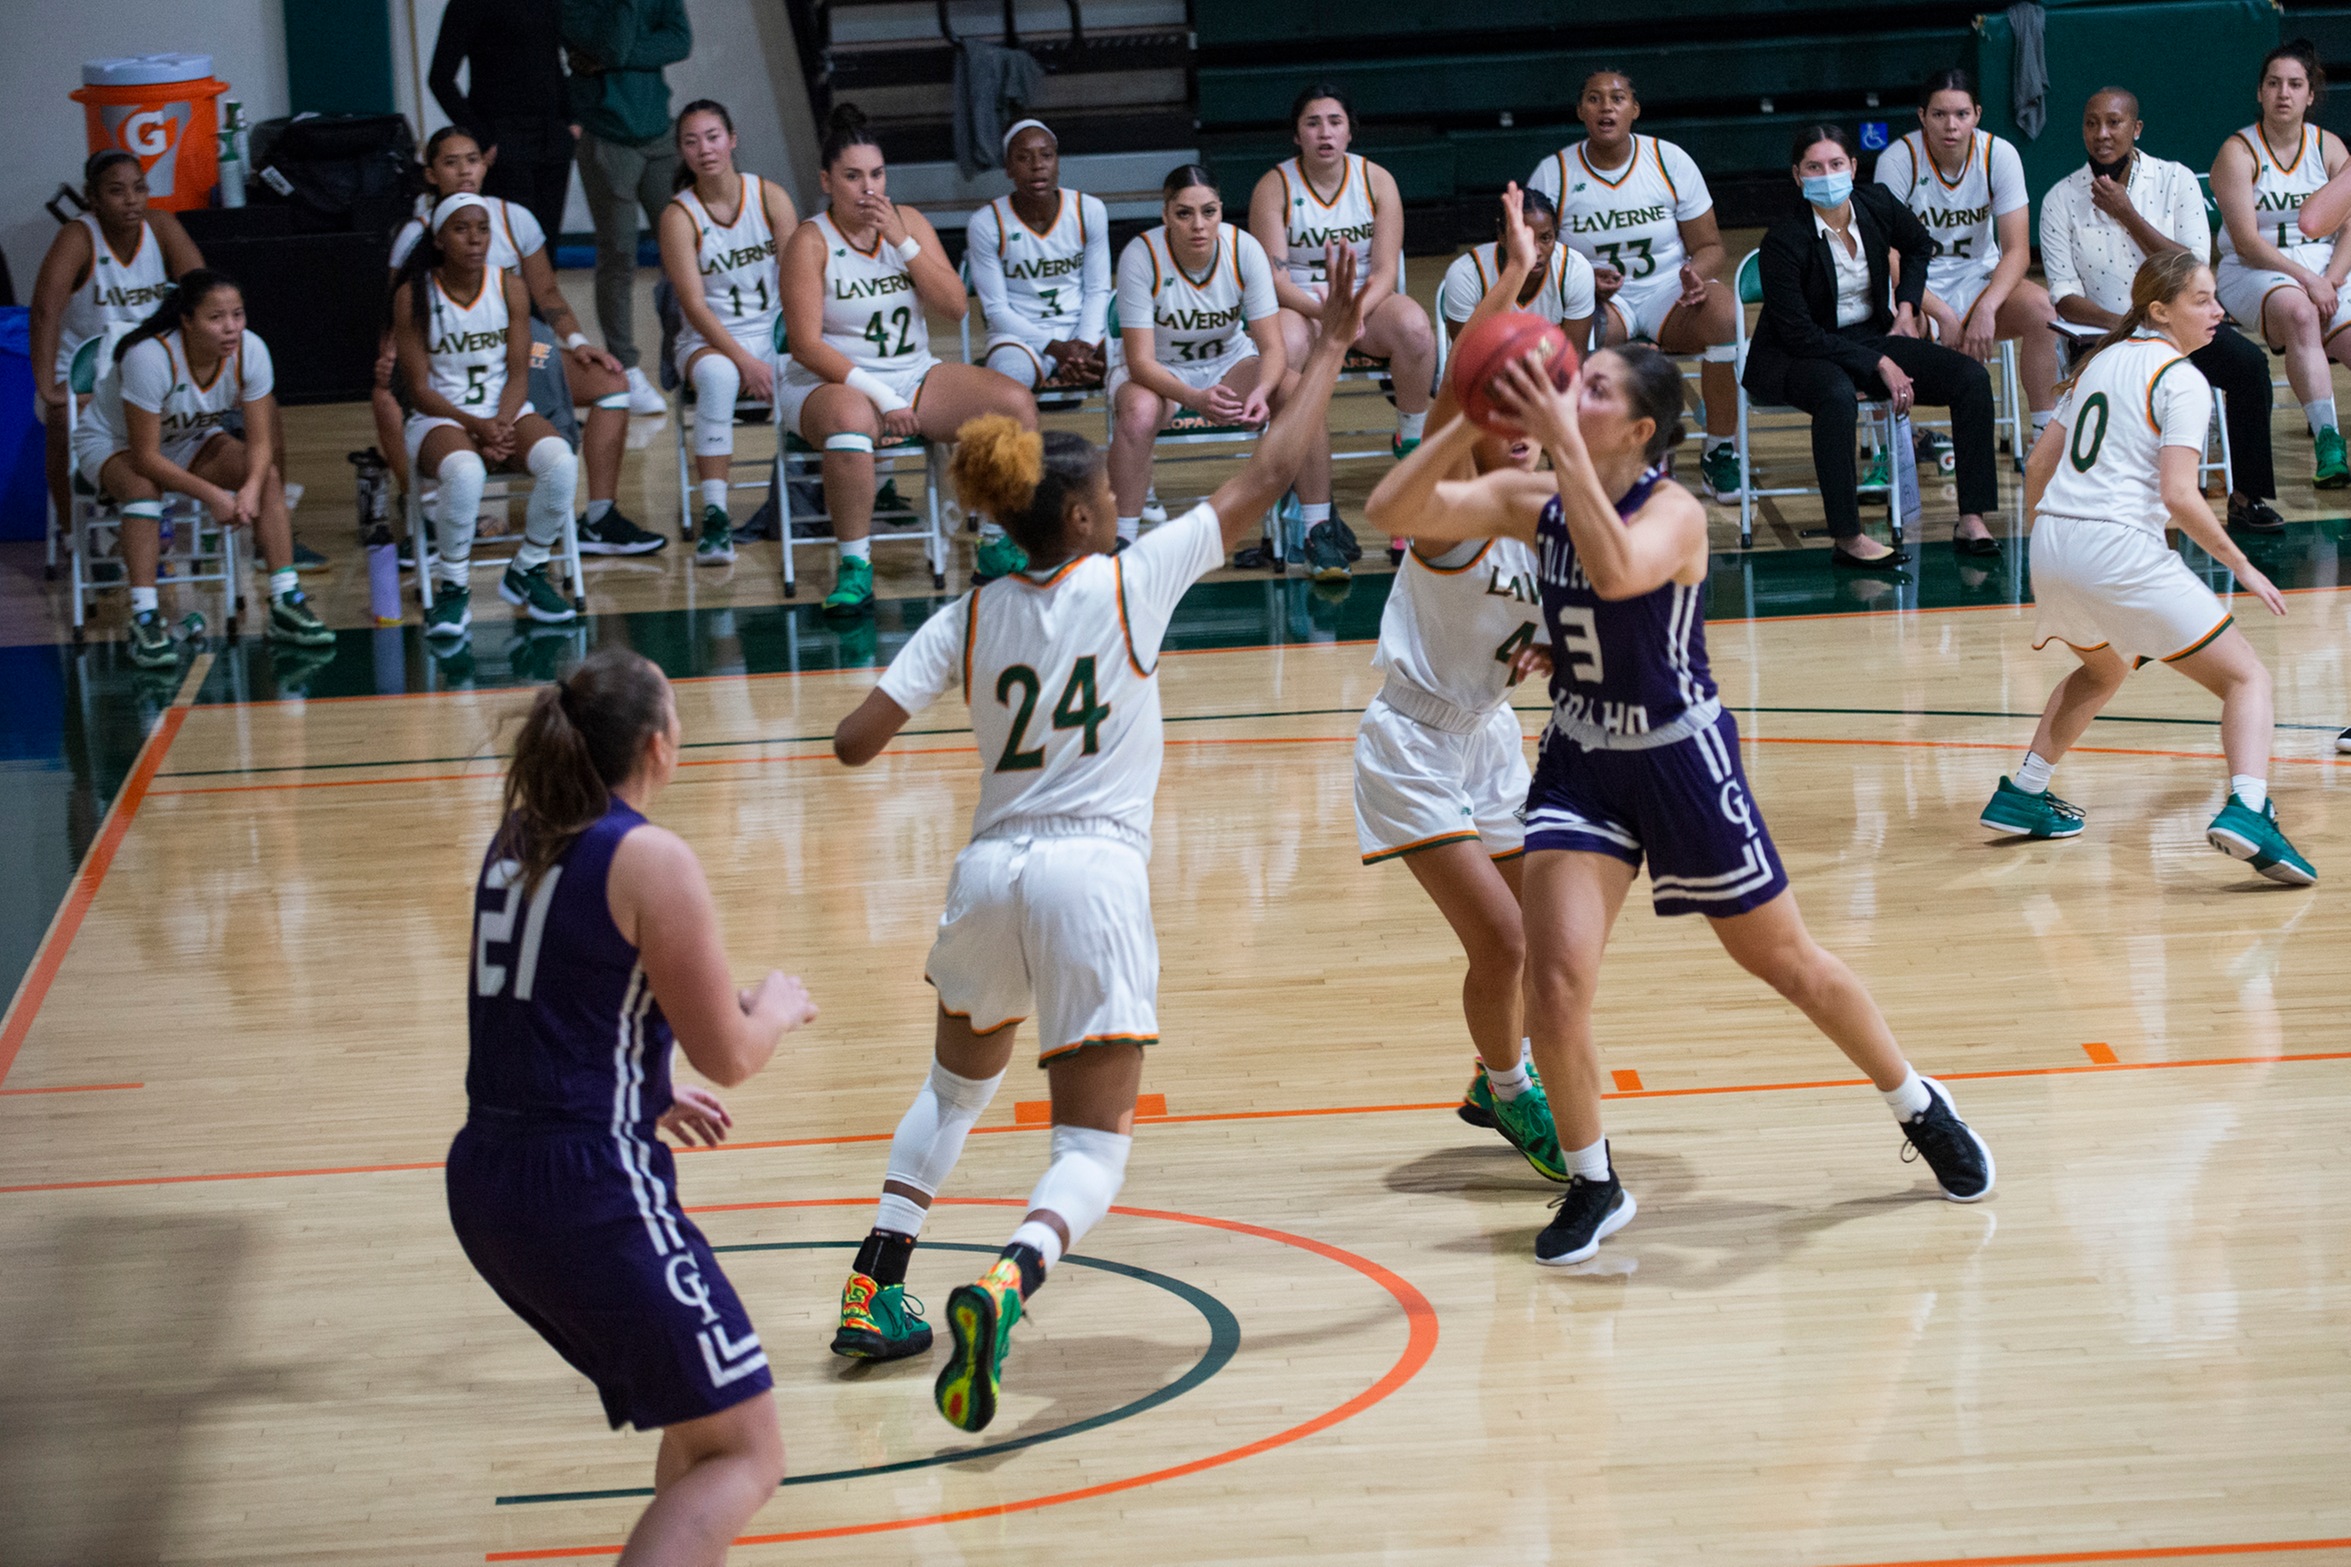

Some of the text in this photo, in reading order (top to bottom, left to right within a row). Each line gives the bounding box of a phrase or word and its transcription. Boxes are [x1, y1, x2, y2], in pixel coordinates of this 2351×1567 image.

[125, 110, 167, 156] G
[1908, 203, 1991, 229] AVERNE
[1595, 238, 1656, 280] 33
[728, 276, 769, 317] 11
[835, 273, 916, 300] LAVERN
[864, 306, 916, 358] 42
[464, 365, 488, 405] 5
[2071, 391, 2109, 473] 0
[1558, 605, 1604, 685] 3
[993, 654, 1111, 774] 24
[476, 859, 563, 1000] 21
